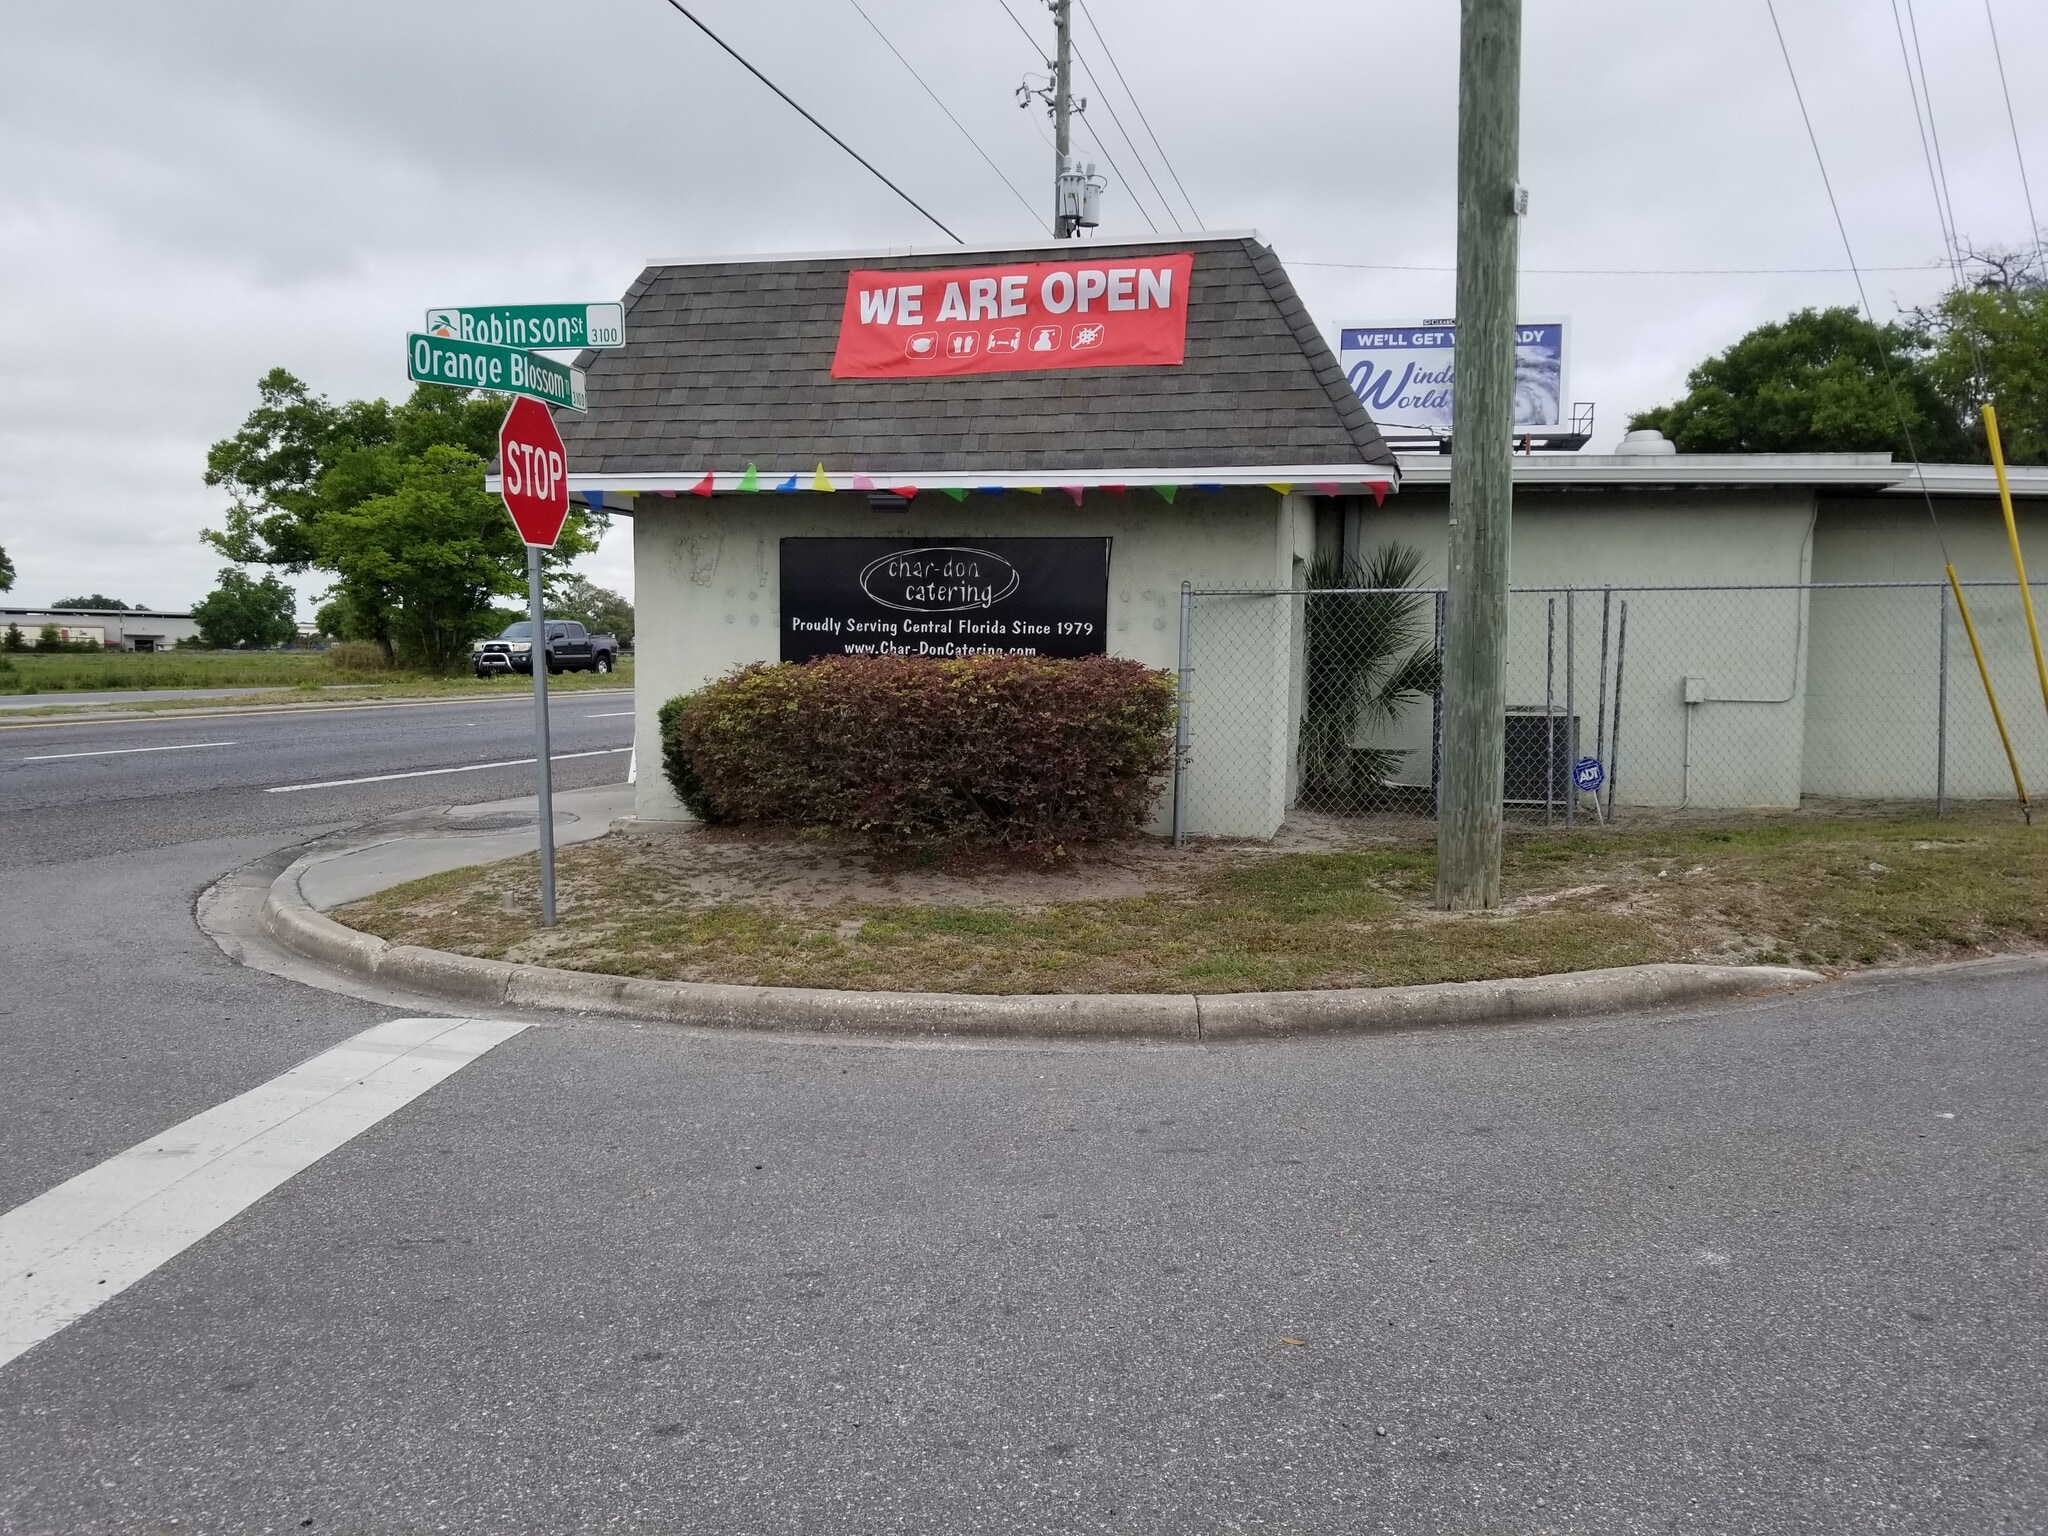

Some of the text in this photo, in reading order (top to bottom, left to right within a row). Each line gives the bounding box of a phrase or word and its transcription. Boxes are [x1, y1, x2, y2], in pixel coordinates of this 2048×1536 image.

[860, 268, 1173, 326] WE ARE OPEN
[461, 312, 618, 344] Robinson St 3100
[1357, 333, 1407, 347] WE'LL
[1412, 332, 1445, 345] GET
[415, 339, 503, 387] Orange
[510, 353, 566, 399] Blossom
[507, 440, 563, 502] STOP
[888, 555, 980, 578] char-don
[905, 580, 993, 609] catering
[792, 617, 1095, 636] Proudly Serving Central Florida Since 1979
[1579, 766, 1599, 784] ADT
